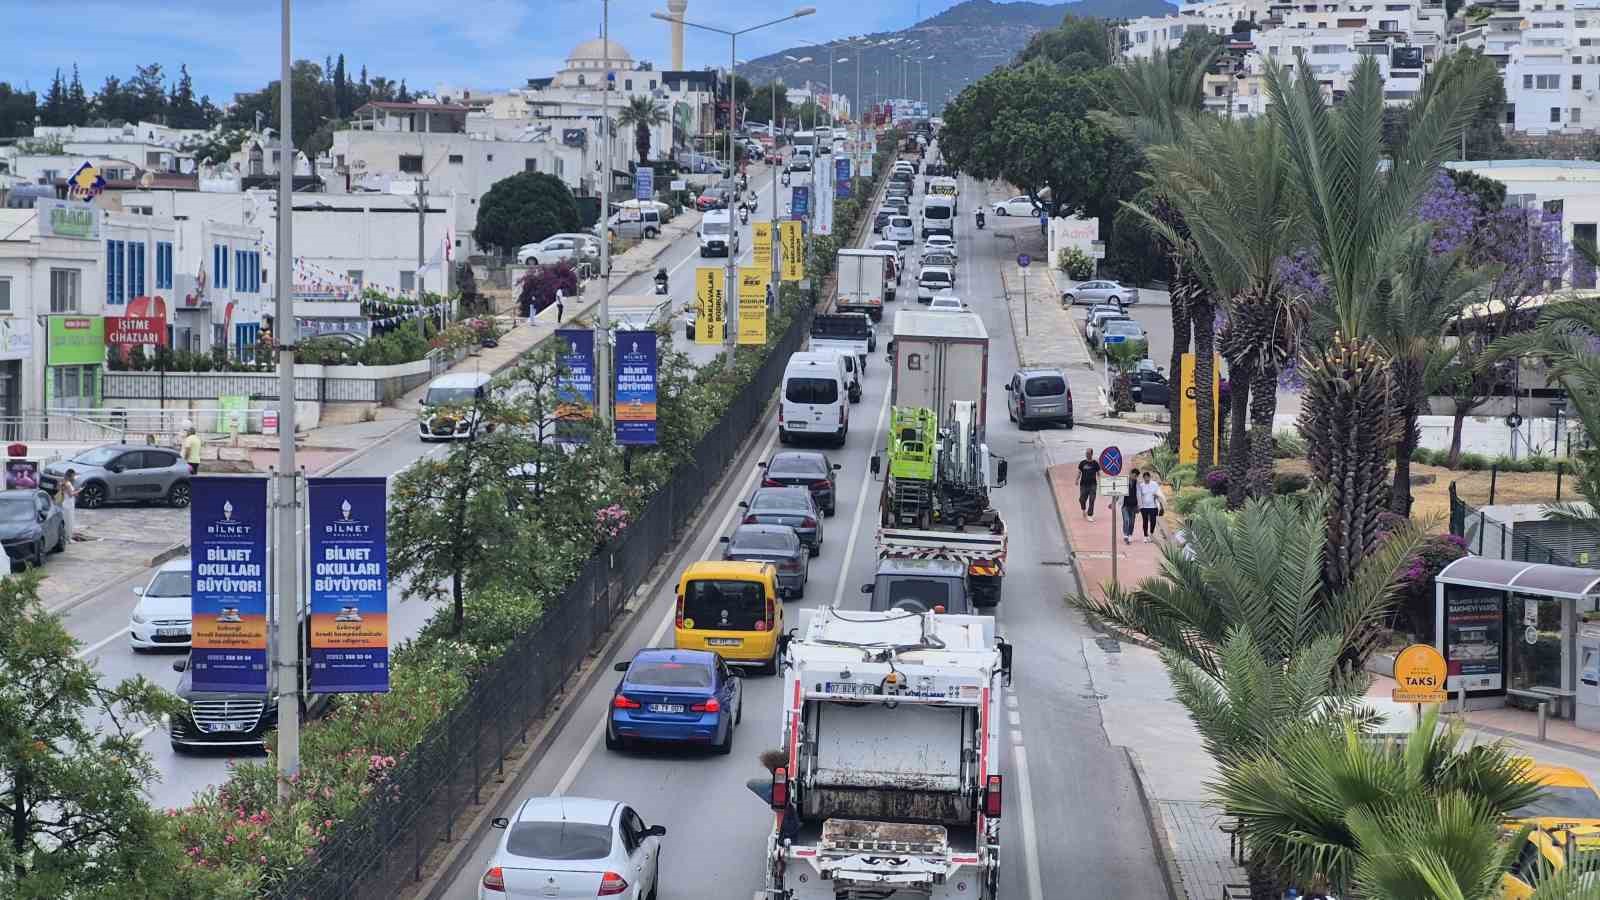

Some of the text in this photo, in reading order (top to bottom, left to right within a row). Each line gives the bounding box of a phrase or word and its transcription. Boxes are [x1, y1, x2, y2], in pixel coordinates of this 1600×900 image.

[118, 318, 151, 331] İŞİTME
[110, 329, 159, 343] CİHAZLARI
[207, 524, 252, 534] BİLNET
[325, 523, 369, 533] BİLNET
[207, 545, 252, 561] BİLNET
[325, 545, 371, 560] BİLNET
[198, 563, 261, 576] OKULLARI
[316, 562, 380, 576] OKULLARI
[196, 577, 262, 592] BÜYÜYOR!
[314, 576, 382, 592] BÜYÜYOR!
[1406, 674, 1437, 686] TAKSİ
